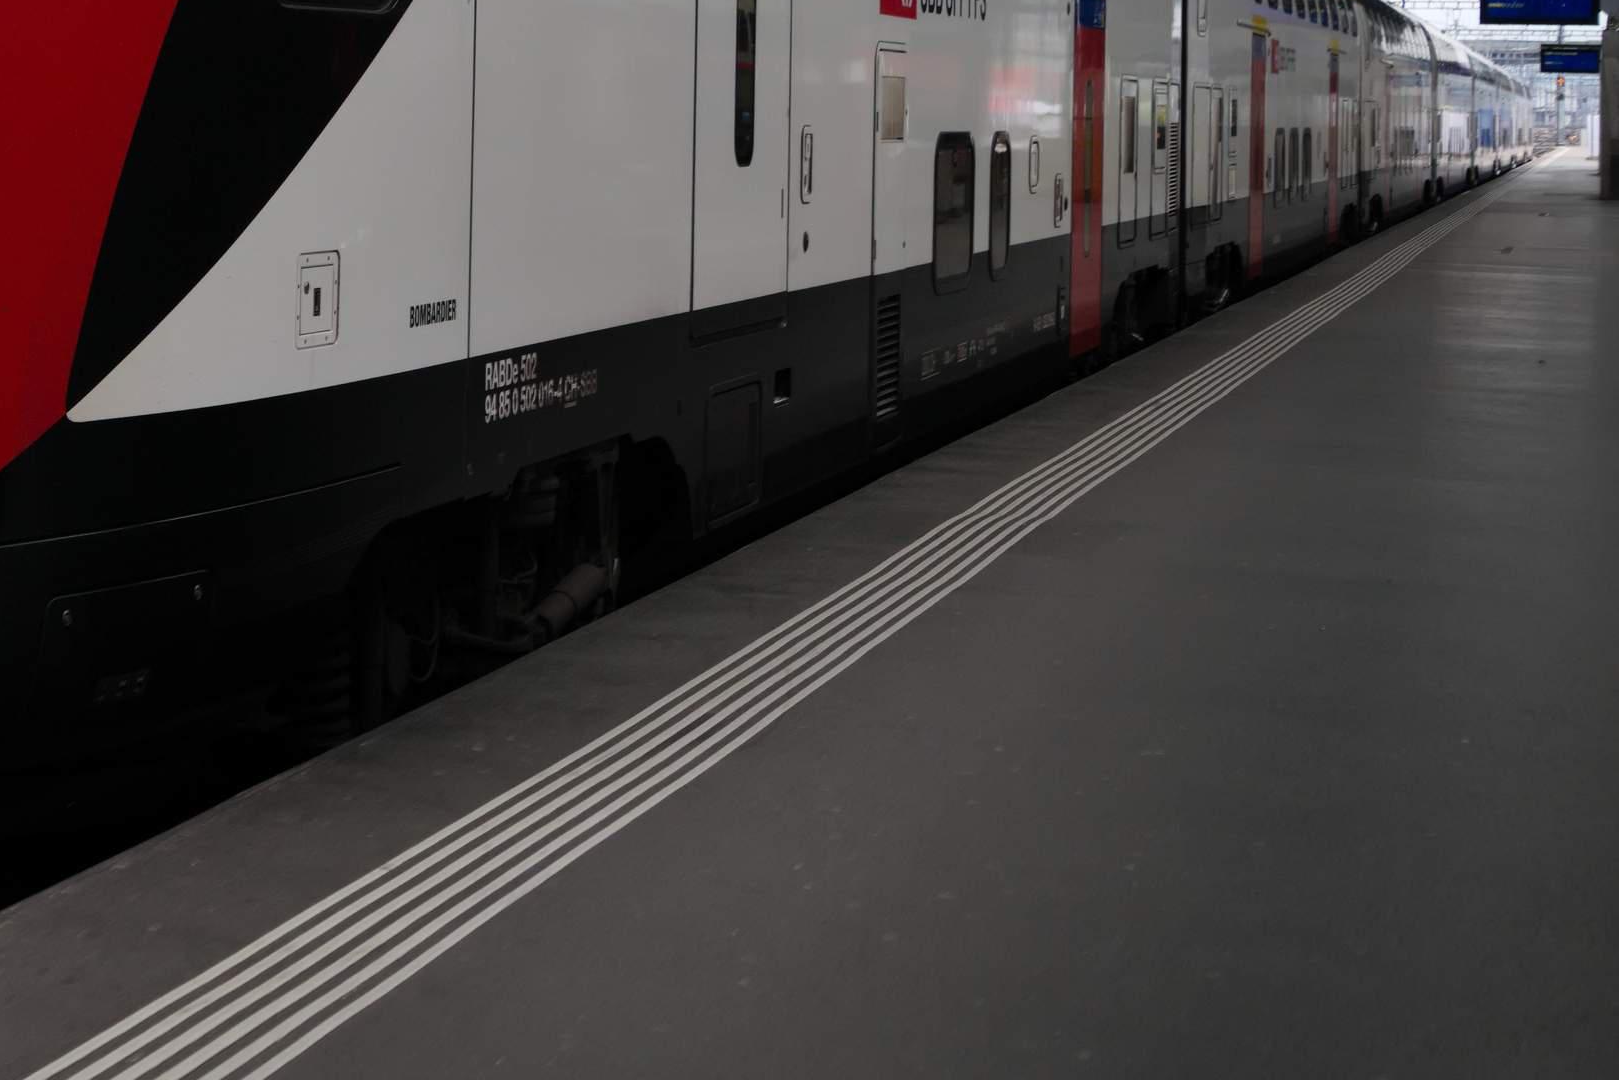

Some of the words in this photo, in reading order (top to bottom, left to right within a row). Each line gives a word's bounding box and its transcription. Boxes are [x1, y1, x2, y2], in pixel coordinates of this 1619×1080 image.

[409, 299, 457, 328] BOMBARDIER
[485, 358, 519, 391] RABDe
[520, 352, 537, 382] 502
[484, 394, 497, 424] 94
[498, 390, 511, 419] 85
[512, 389, 519, 416] 0
[520, 383, 537, 412] 502
